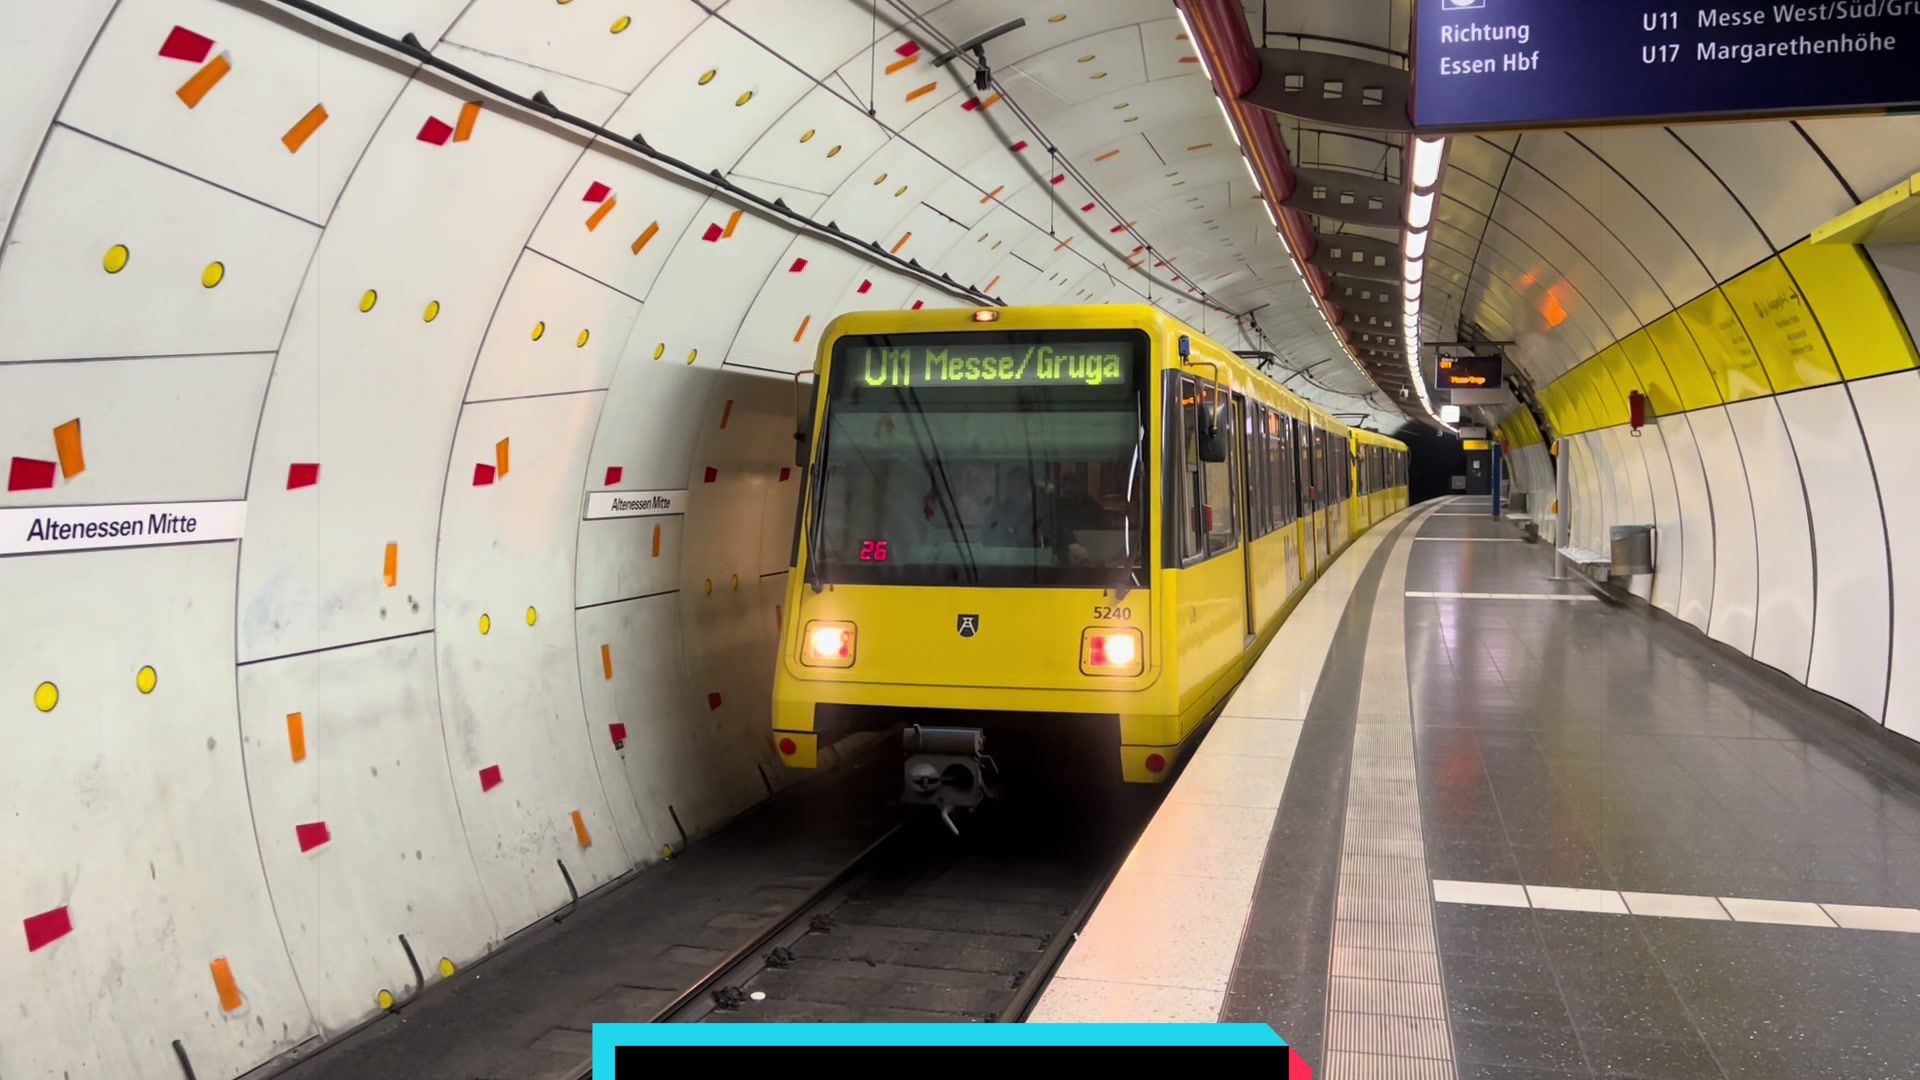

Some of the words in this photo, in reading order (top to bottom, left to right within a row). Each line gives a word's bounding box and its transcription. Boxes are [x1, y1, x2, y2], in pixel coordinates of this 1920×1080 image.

[1643, 11, 1678, 31] U11
[1698, 9, 1765, 28] Messe
[1441, 23, 1530, 44] Richtung
[1642, 44, 1680, 64] U17
[1697, 32, 1896, 63] Margarethenhöhe
[1440, 57, 1496, 75] Essen
[1503, 51, 1540, 71] Hbf
[865, 348, 910, 386] U11
[924, 346, 1120, 385] Messe/Gruga
[610, 498, 652, 511] Altenessen
[652, 496, 671, 509] Mitte
[27, 518, 143, 541] Altenessen
[147, 513, 197, 535] Mitte
[861, 541, 887, 560] 26
[1093, 606, 1131, 620] 5240
